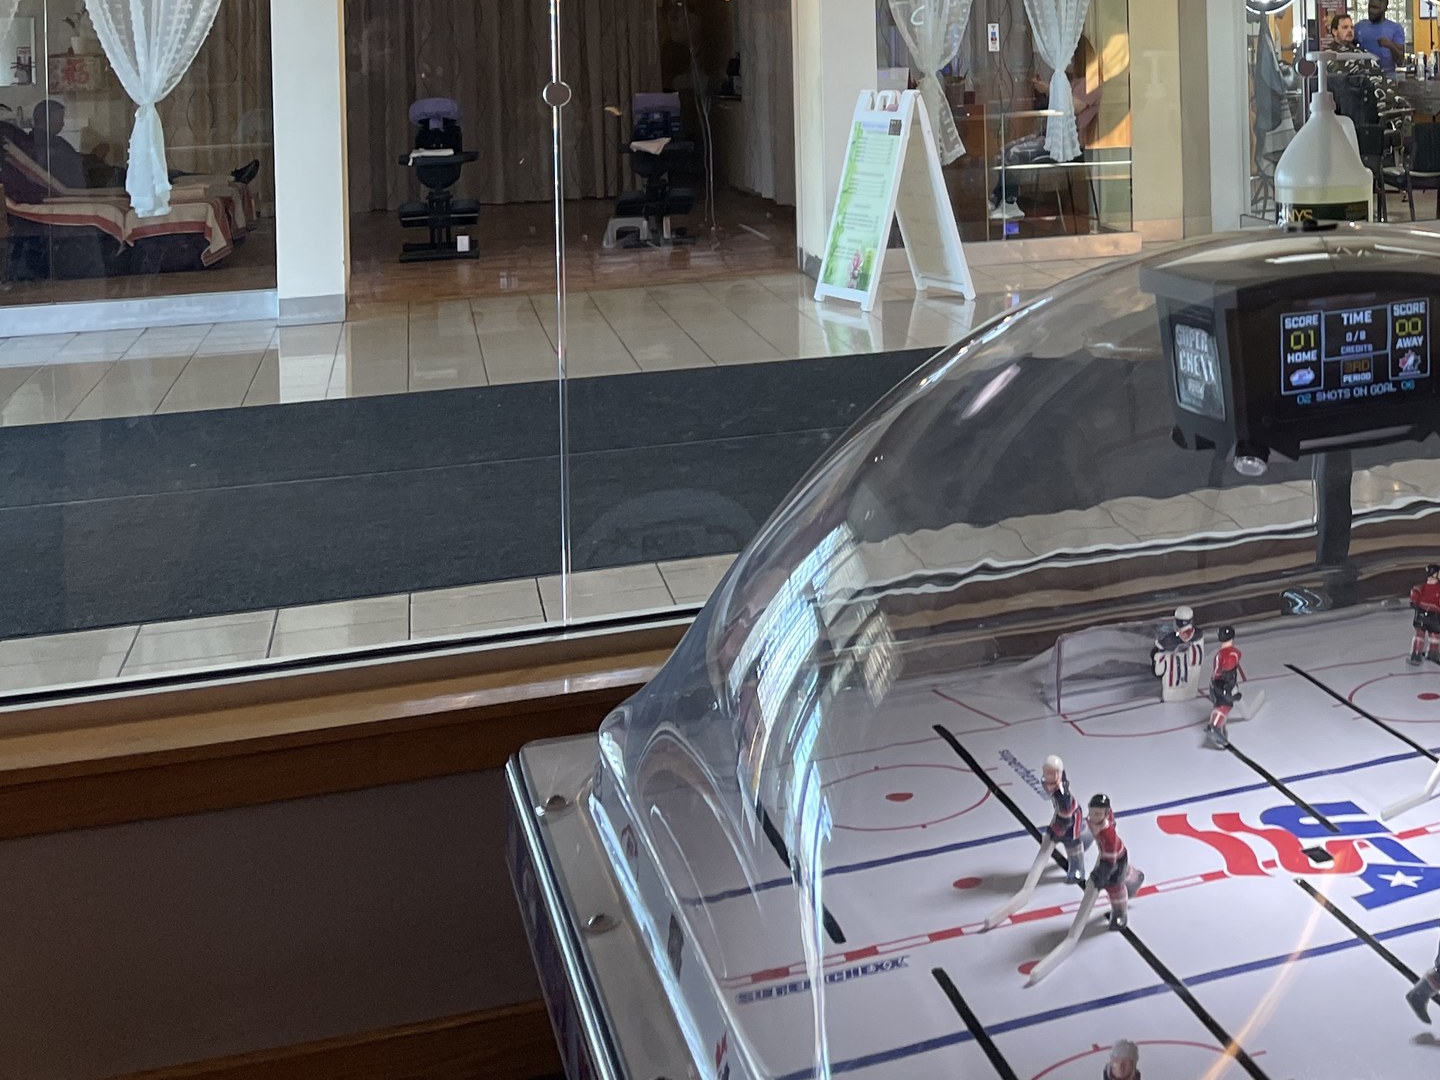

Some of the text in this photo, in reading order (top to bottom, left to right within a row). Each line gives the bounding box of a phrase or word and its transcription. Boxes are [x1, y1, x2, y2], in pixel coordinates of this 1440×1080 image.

[1284, 301, 1426, 330] SCORE TIME SCORE
[1290, 329, 1315, 351] 01
[1395, 318, 1422, 336] 00
[1287, 335, 1424, 364] HOME CREDITS AWAY
[1316, 387, 1351, 402] SHOTS
[1353, 385, 1368, 397] ON
[1370, 382, 1397, 395] GOAL
[1343, 372, 1372, 383] PERIOD
